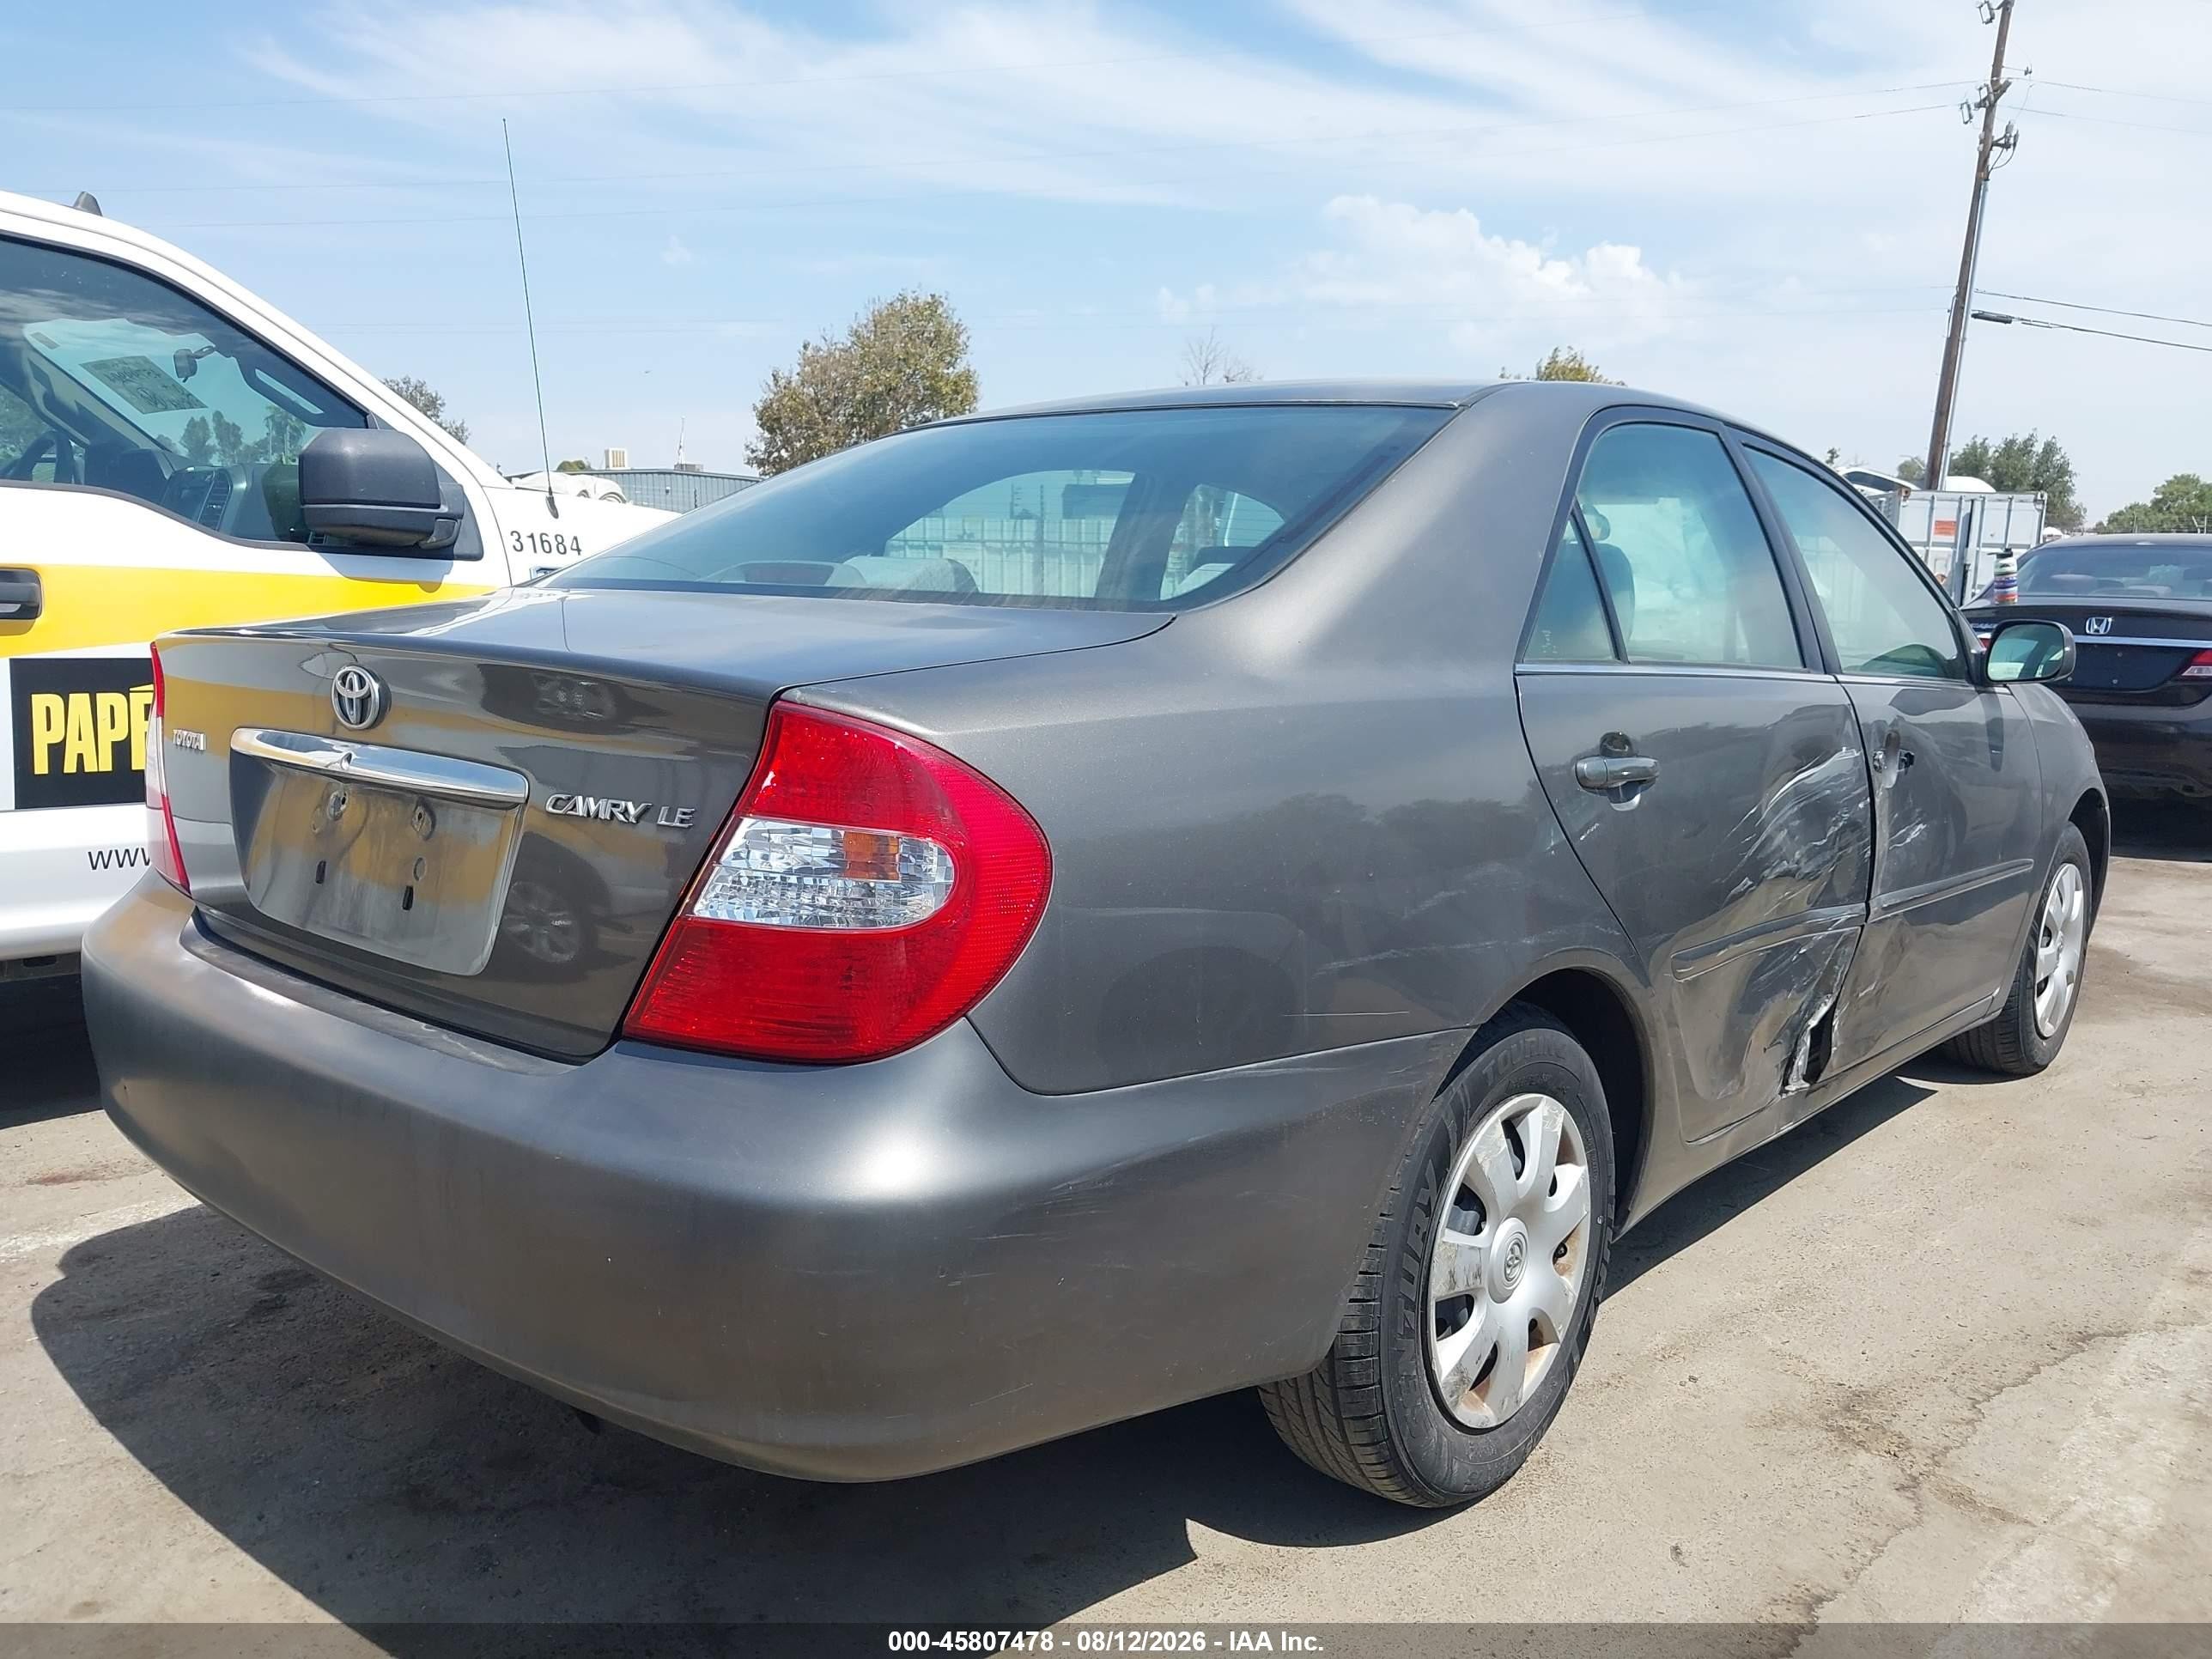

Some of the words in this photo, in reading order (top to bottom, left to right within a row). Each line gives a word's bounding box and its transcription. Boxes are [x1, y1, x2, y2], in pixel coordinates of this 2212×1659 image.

[510, 530, 582, 556] 31684
[173, 729, 206, 750] TOYOTA
[545, 793, 653, 823] CAMRY
[657, 805, 696, 828] LE
